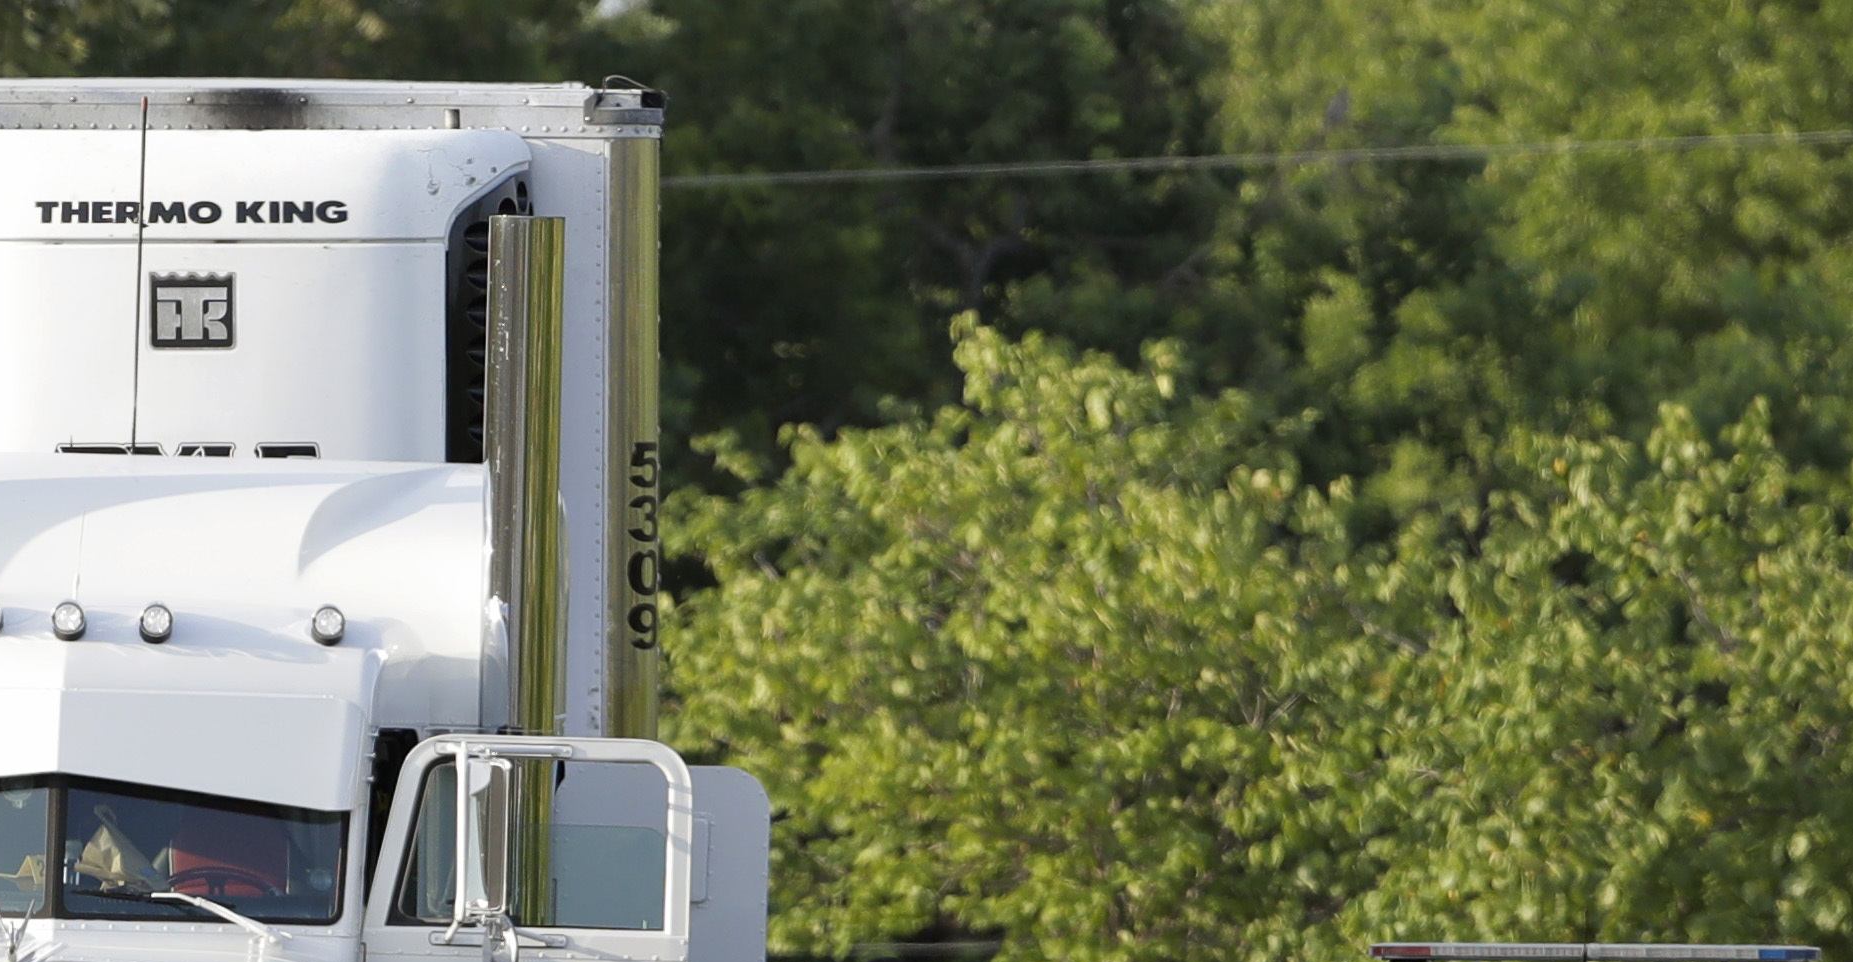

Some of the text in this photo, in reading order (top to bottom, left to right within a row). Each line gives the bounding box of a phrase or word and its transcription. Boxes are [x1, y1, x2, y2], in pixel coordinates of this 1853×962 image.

[35, 200, 348, 224] THERMO KING
[627, 442, 658, 650] 5309
